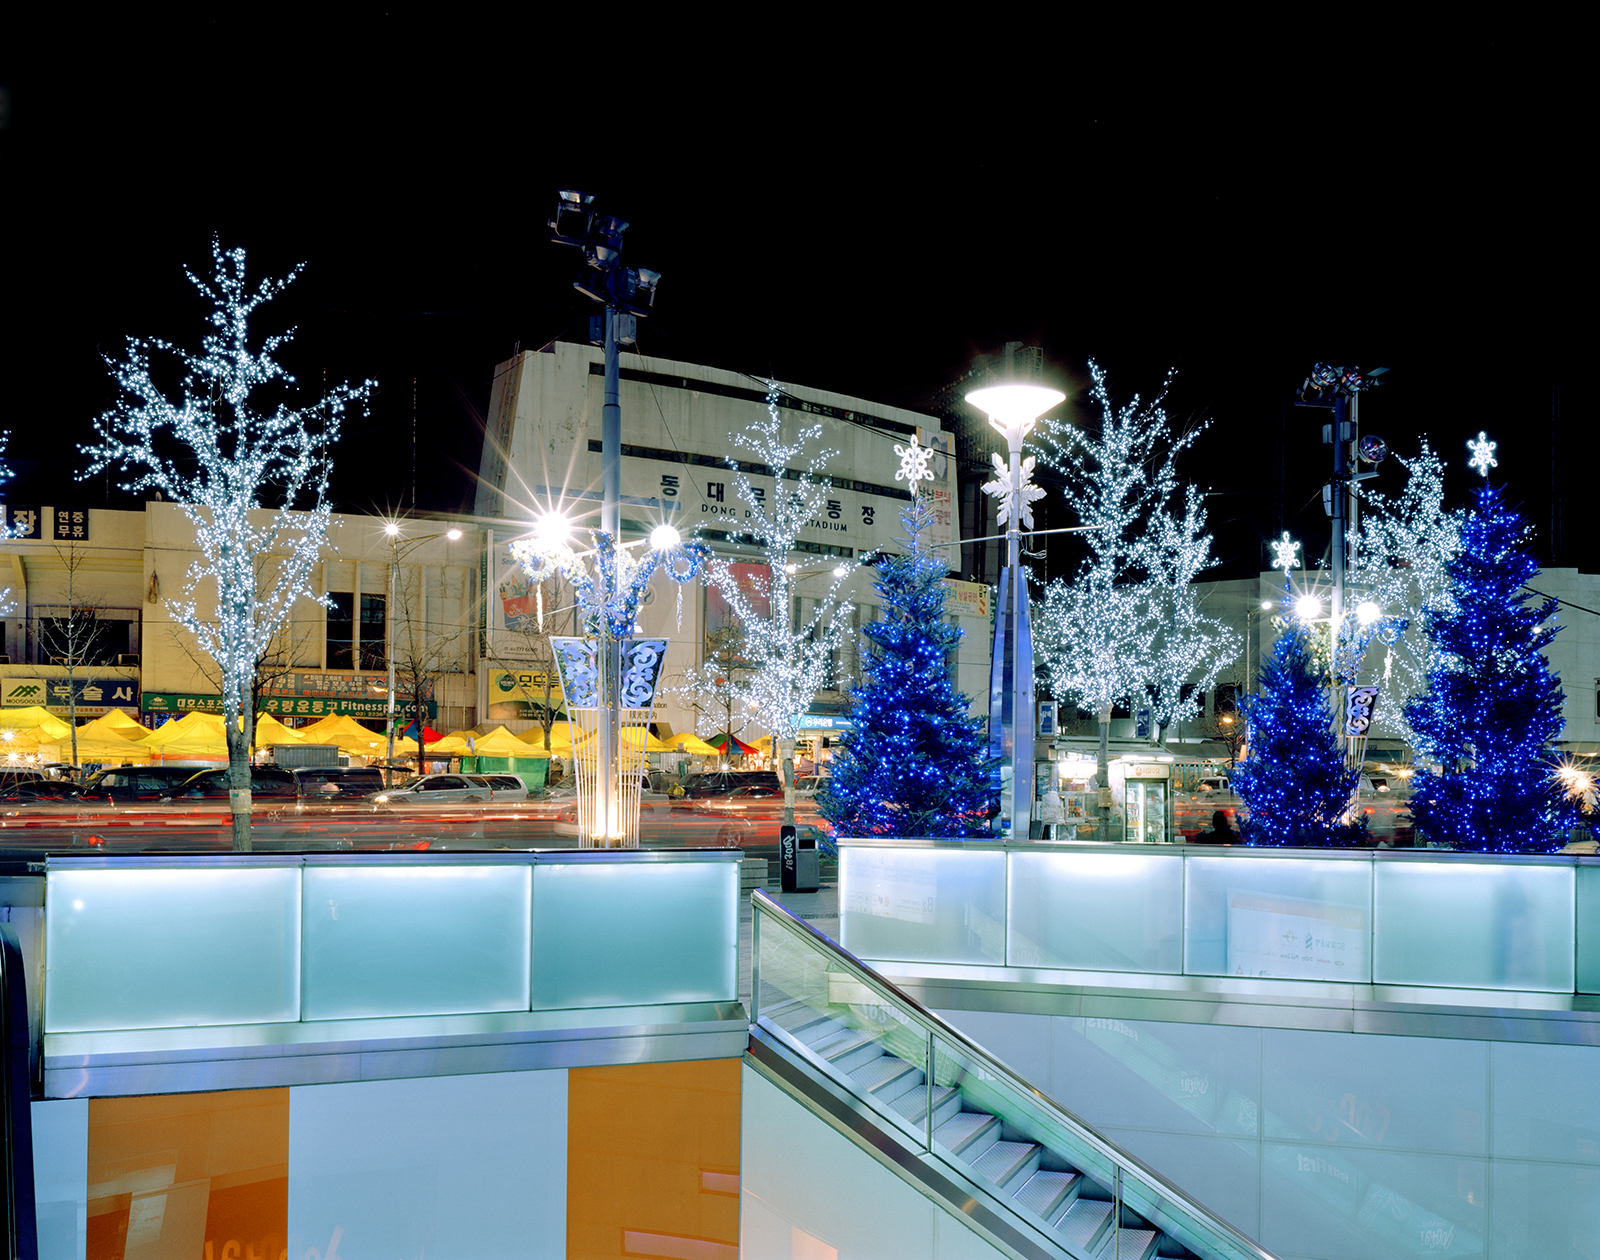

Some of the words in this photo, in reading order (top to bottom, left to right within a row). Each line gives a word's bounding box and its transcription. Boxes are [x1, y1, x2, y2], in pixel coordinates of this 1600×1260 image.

[701, 503, 736, 516] DONG
[58, 511, 84, 523] 연중
[58, 525, 84, 537] 무휴
[341, 702, 428, 714] Fitnesspacom
